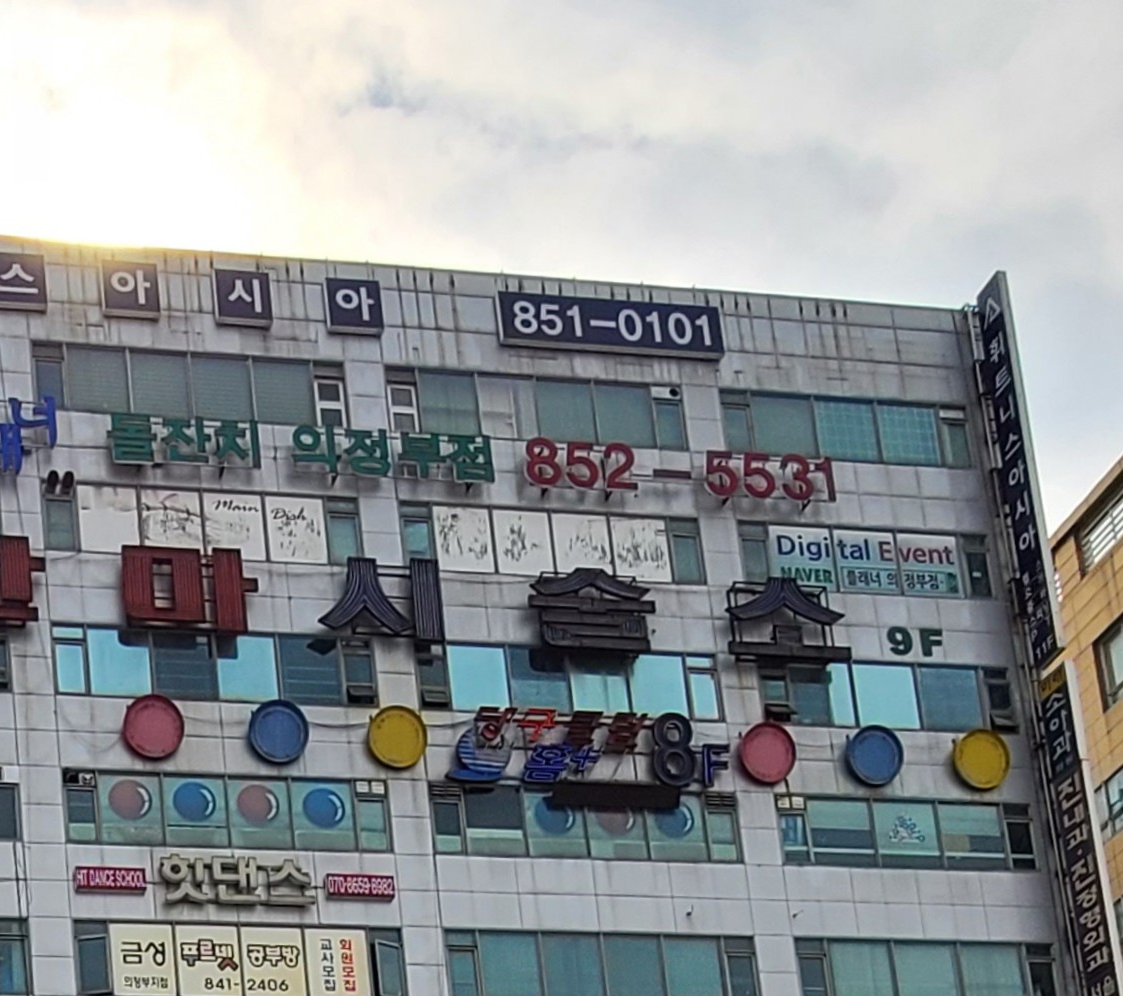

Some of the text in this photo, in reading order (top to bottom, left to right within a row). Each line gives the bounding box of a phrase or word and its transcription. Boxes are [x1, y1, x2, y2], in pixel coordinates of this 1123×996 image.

[511, 299, 714, 347] 851-0101
[107, 412, 261, 469] 돌잔치
[292, 423, 496, 484] 의정부점
[776, 534, 955, 566] Digital Event
[780, 566, 834, 585] NAVER
[886, 626, 943, 657] 9F
[120, 940, 166, 966] 금성
[246, 943, 300, 968] 공부방
[204, 978, 289, 992] 841-2406
